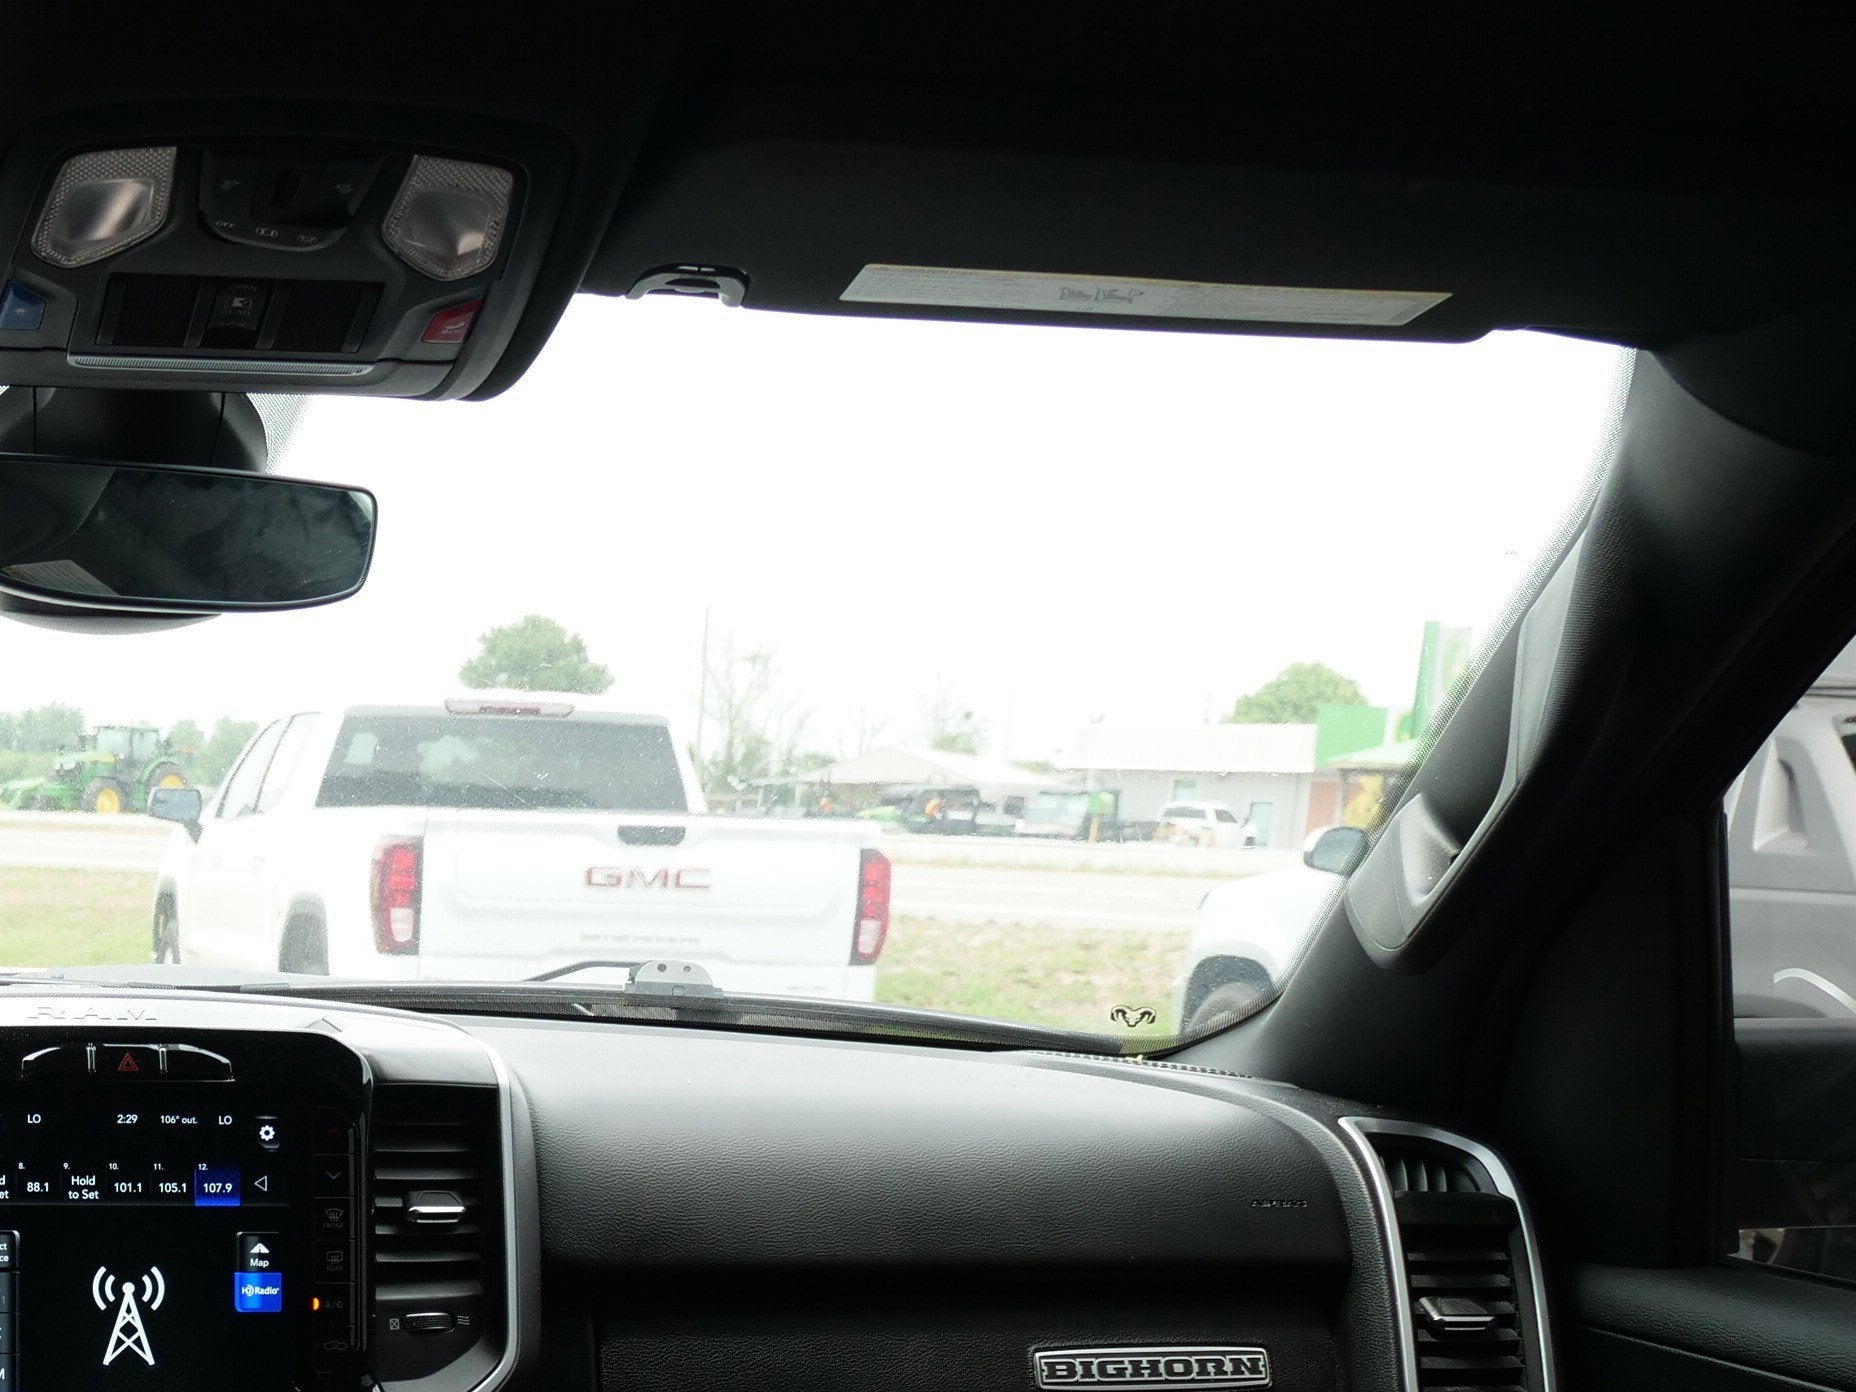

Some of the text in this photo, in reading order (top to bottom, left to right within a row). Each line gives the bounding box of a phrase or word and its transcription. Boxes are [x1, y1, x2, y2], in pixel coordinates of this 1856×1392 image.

[584, 865, 712, 890] GMC
[26, 1113, 42, 1125] LO
[116, 1113, 139, 1125] 2:29
[217, 1115, 233, 1126] LO
[26, 1181, 50, 1193] 88.1
[70, 1175, 96, 1187] Hold
[113, 1181, 143, 1194] 101.1
[158, 1181, 188, 1194] 105.1
[202, 1182, 234, 1194] 107.9
[68, 1188, 100, 1200] to Set
[249, 1258, 270, 1269] Map
[324, 1300, 345, 1309] A/C
[1042, 1355, 1267, 1382] BIGHORN
